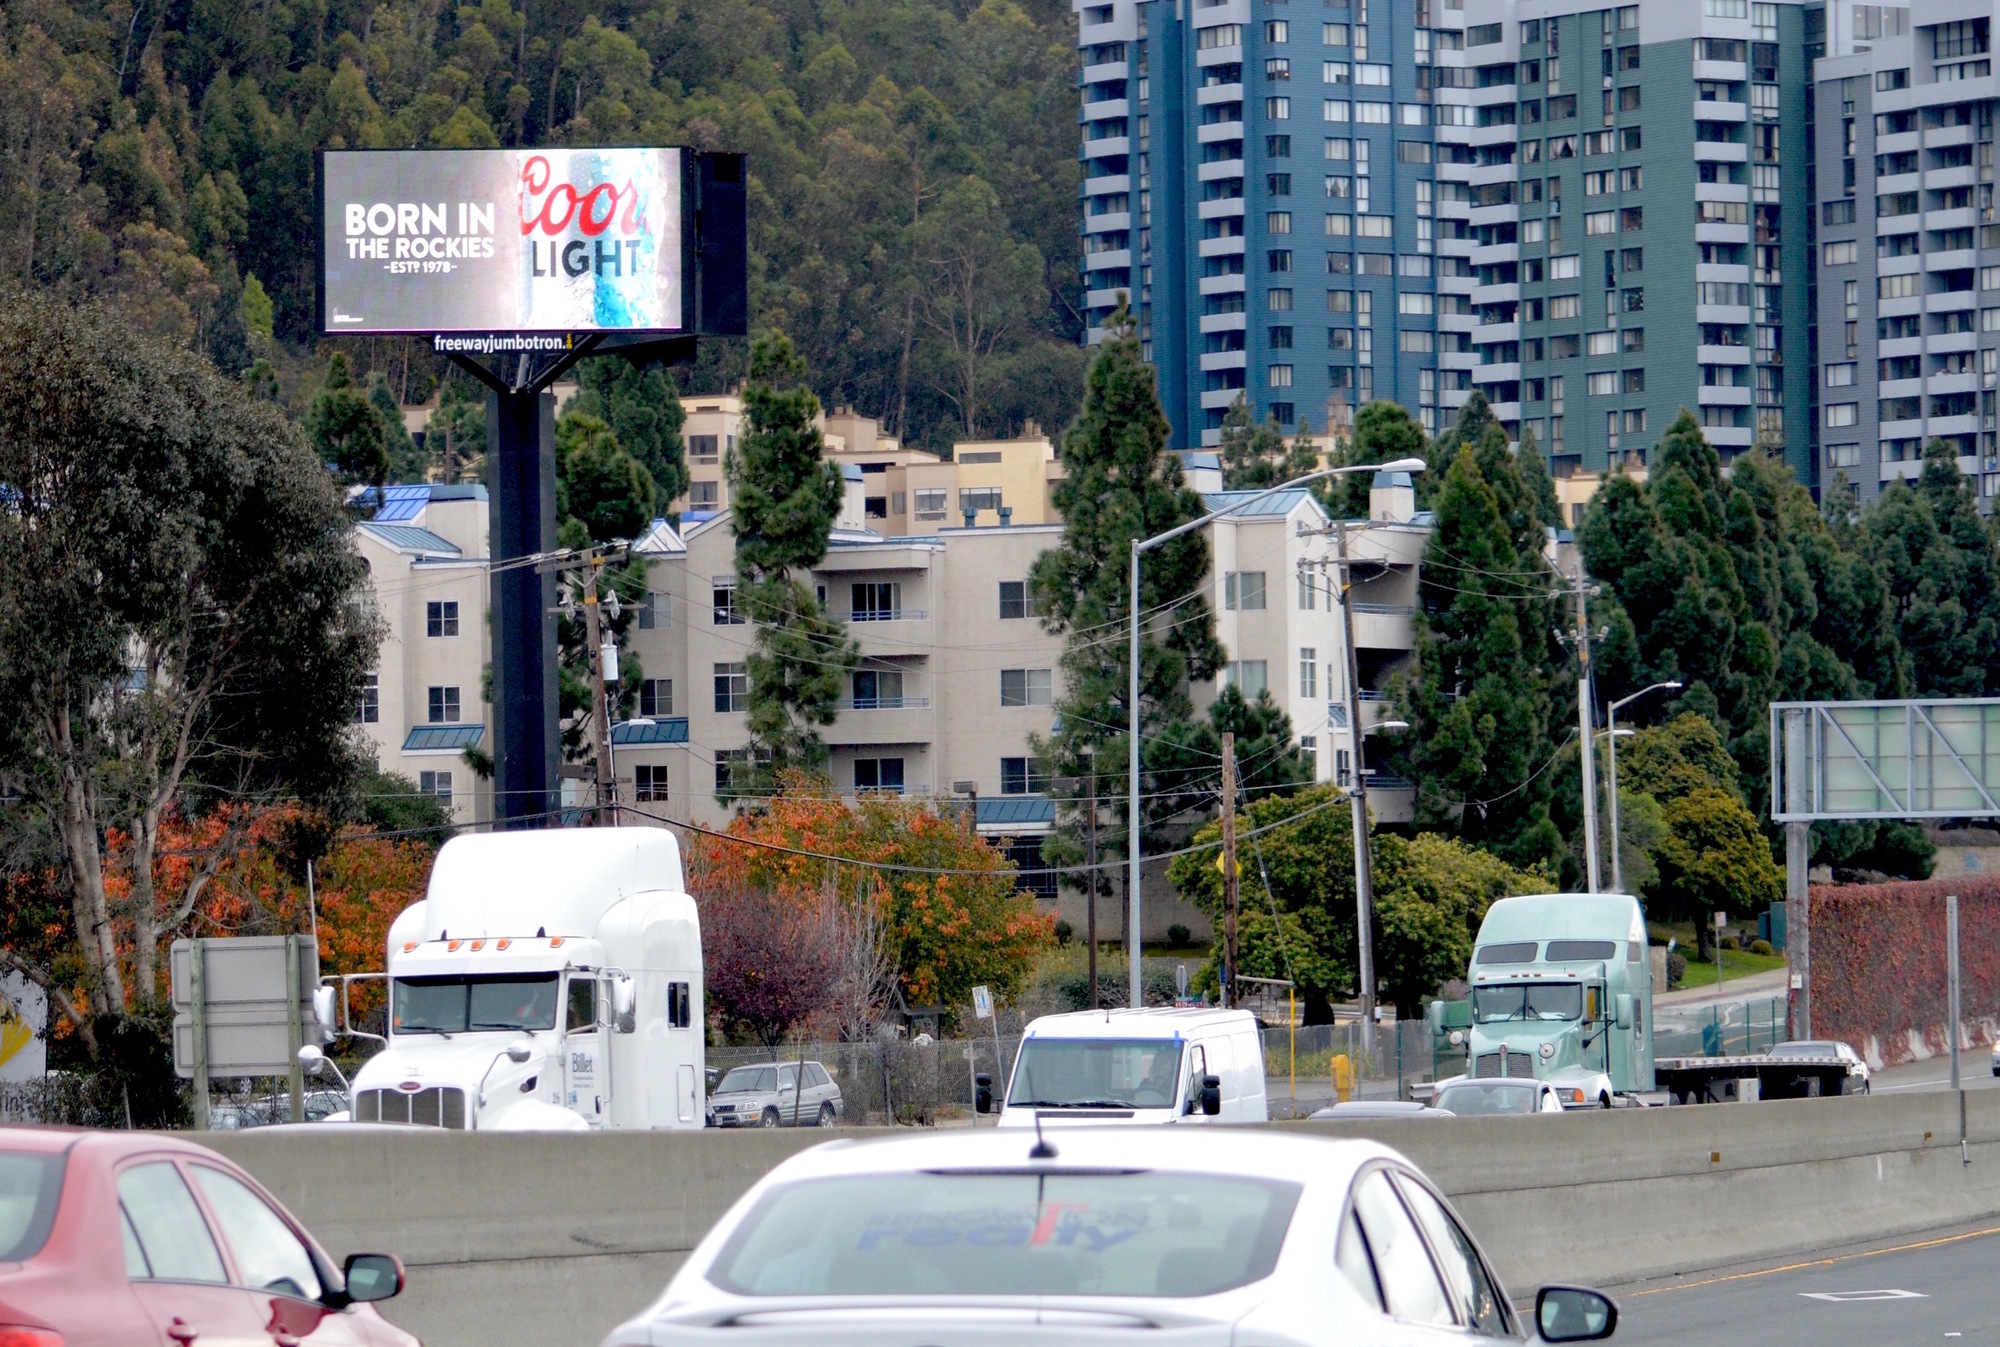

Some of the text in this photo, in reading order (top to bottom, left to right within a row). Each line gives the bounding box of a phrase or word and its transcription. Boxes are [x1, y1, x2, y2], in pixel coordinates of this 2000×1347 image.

[346, 202, 495, 236] BORN IN
[346, 237, 495, 259] THE ROCKIES
[532, 240, 642, 277] LIGHT
[572, 1053, 593, 1072] Billet
